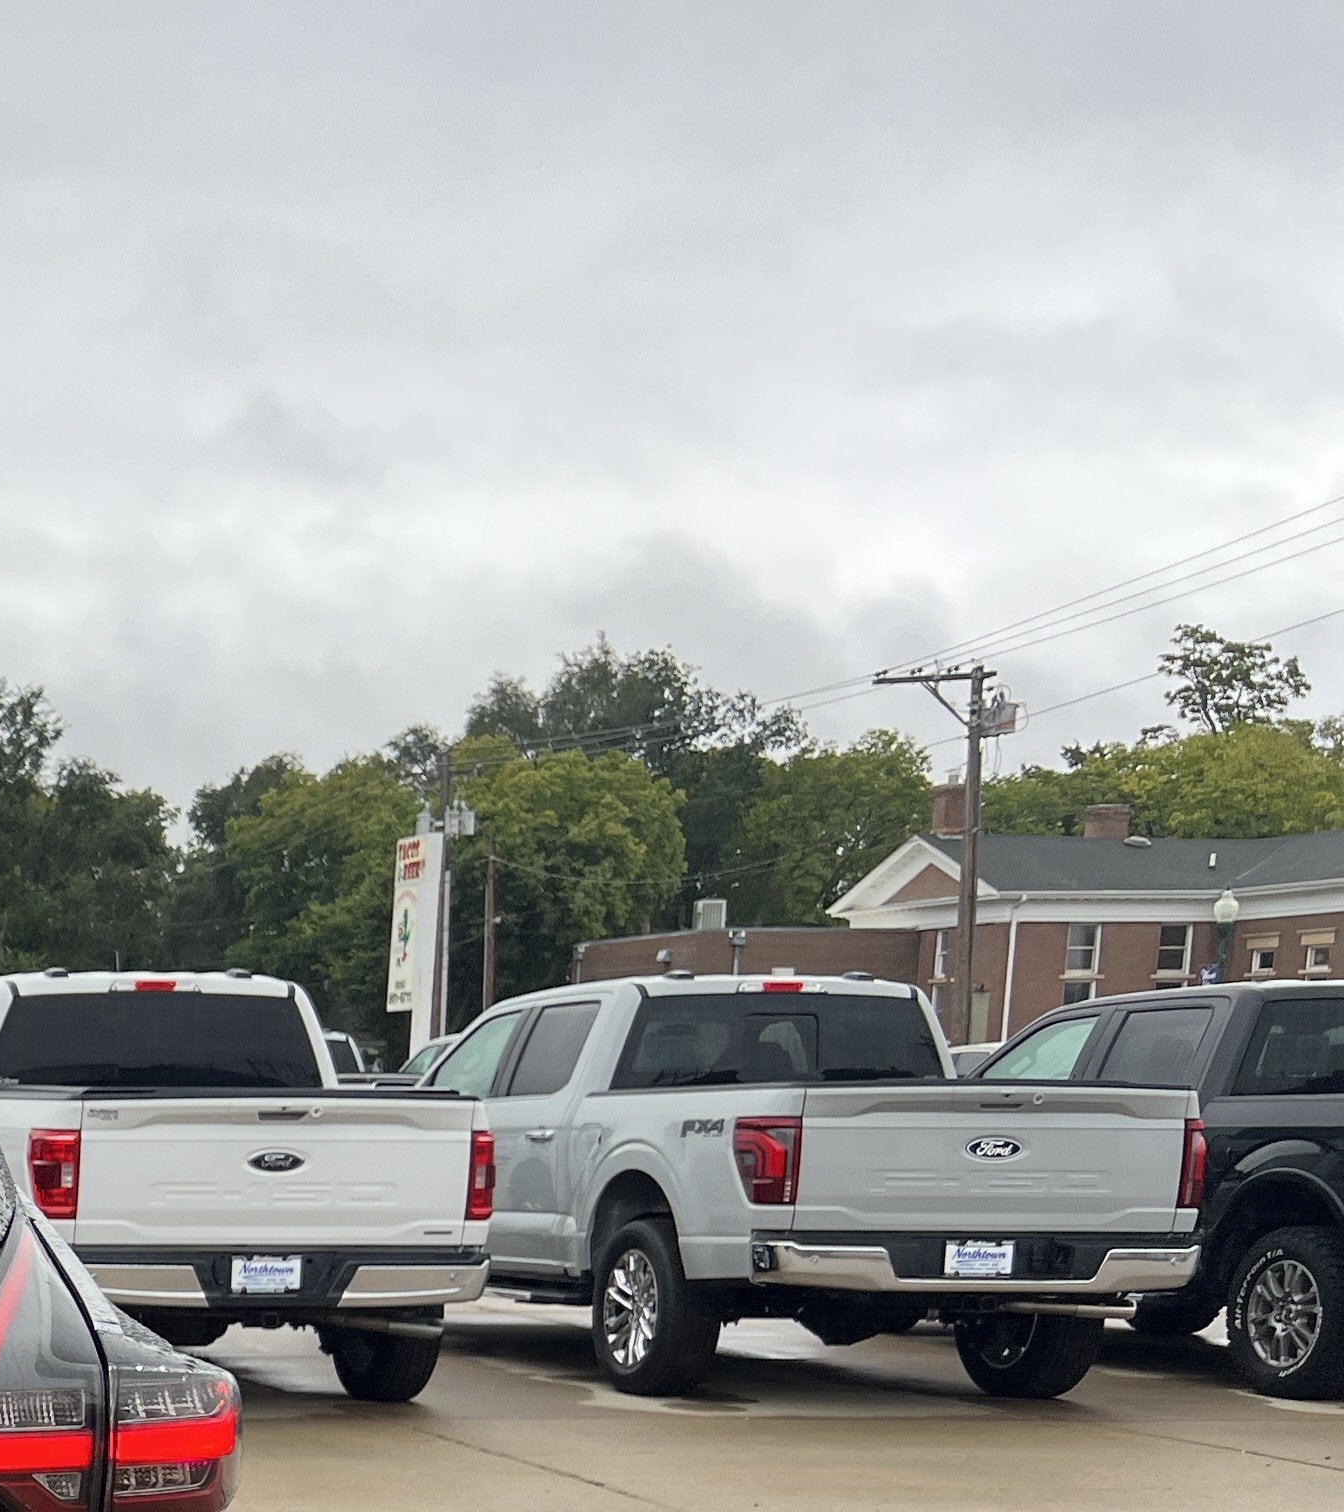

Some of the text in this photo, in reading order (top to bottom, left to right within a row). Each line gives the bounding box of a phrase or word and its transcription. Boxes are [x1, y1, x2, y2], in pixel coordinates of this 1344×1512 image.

[680, 1118, 725, 1138] FX4
[975, 1140, 1014, 1156] Ford
[952, 1247, 1007, 1260] Northtown
